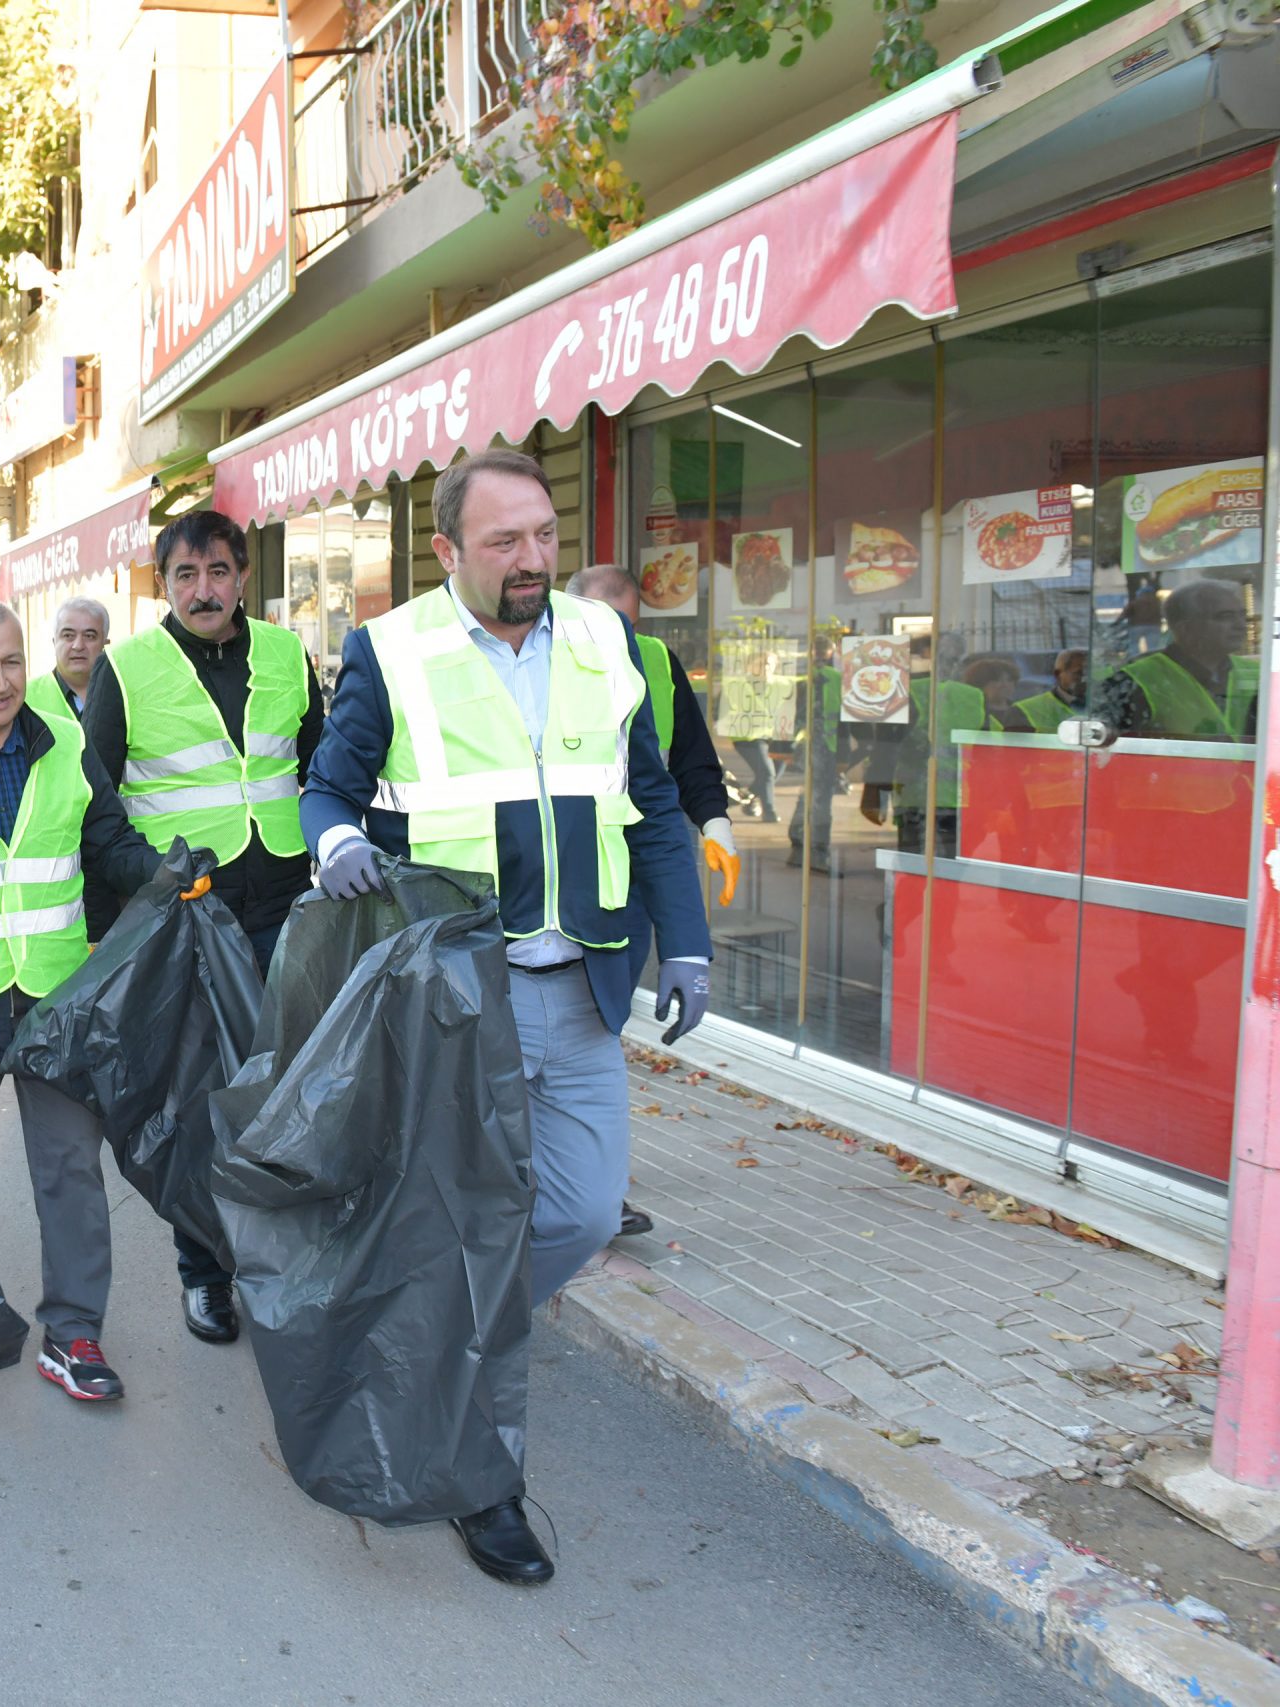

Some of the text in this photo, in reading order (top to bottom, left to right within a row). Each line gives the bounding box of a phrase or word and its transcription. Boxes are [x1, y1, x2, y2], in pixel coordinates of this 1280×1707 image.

[159, 92, 284, 354] TADINDA
[588, 233, 769, 391] 376 48 60
[253, 367, 472, 510] TADINDA KÖFTE
[1221, 471, 1262, 486] EKMEK
[1040, 503, 1071, 518] KURU
[1215, 491, 1259, 508] ARASI
[1025, 521, 1071, 536] FASULYE
[44, 533, 80, 582] CİĞER
